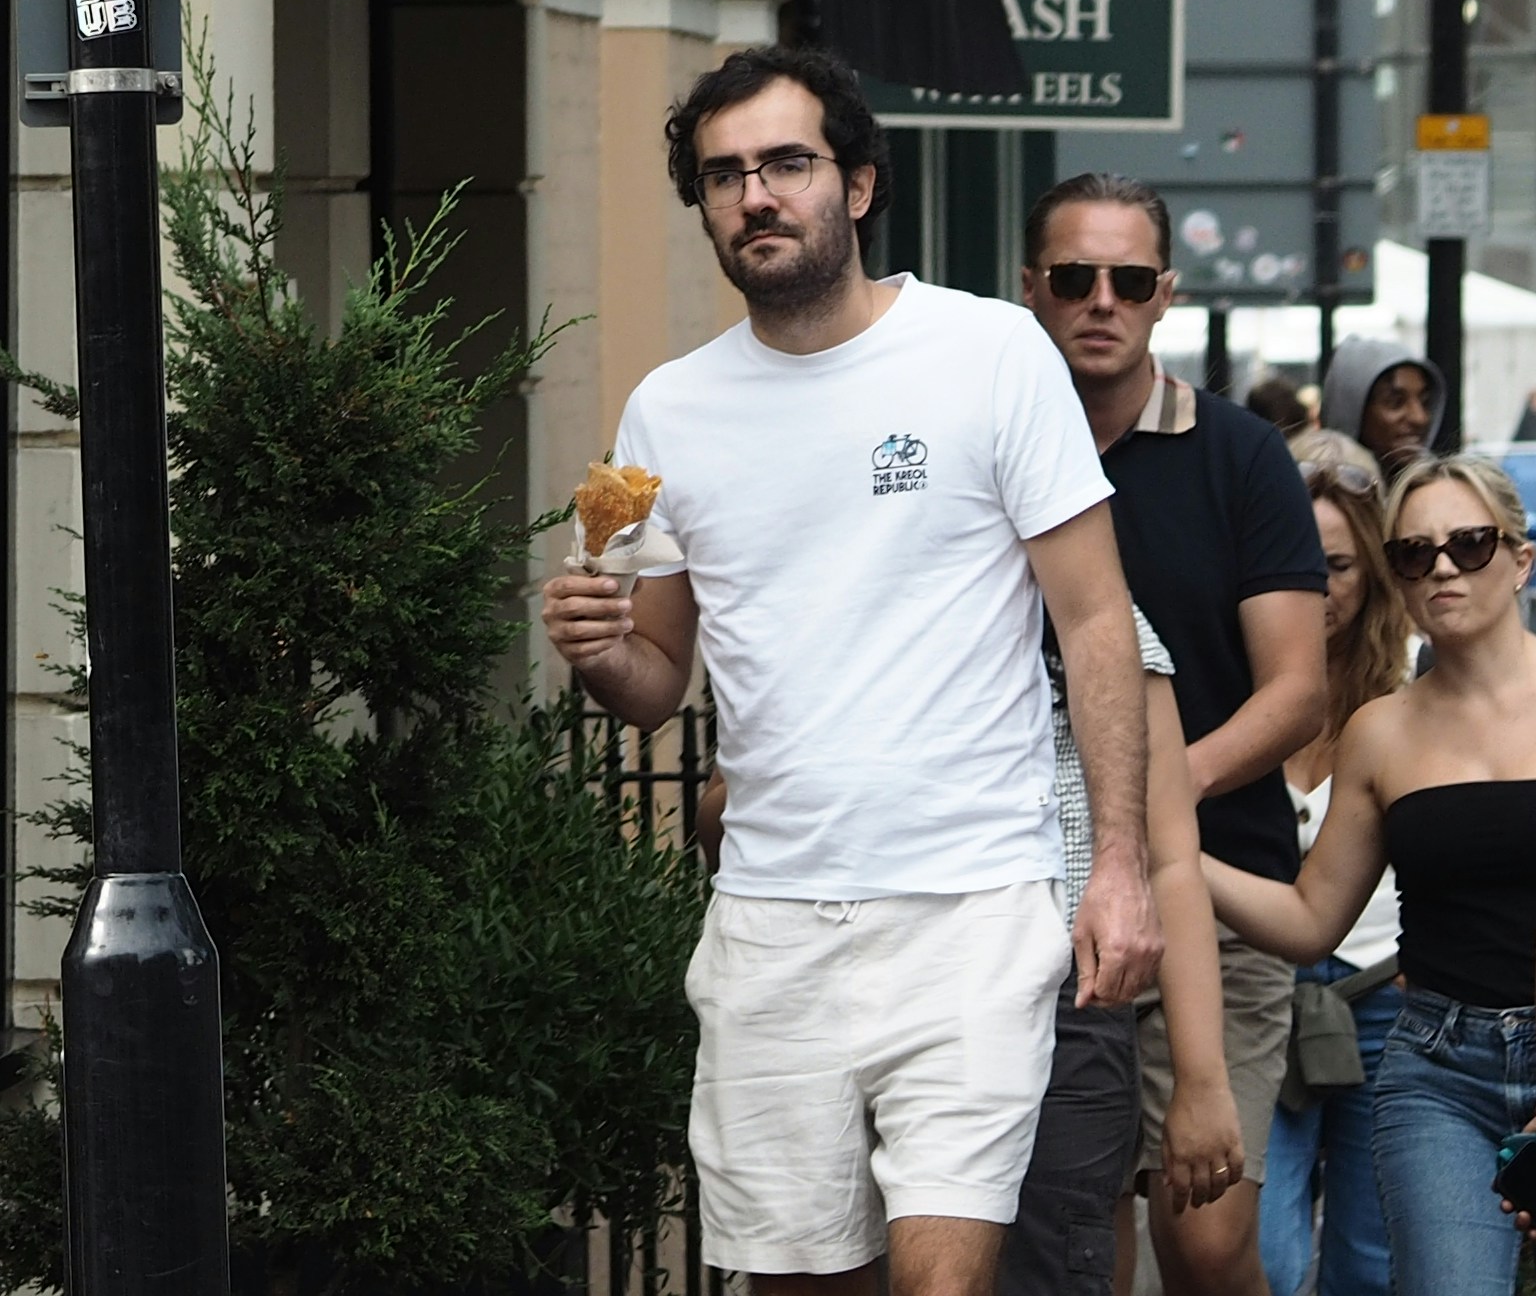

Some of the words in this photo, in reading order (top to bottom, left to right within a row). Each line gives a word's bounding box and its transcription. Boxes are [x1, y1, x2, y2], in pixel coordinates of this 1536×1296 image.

[1032, 71, 1123, 105] EELS
[873, 472, 892, 485] THE
[895, 469, 928, 482] KREOL
